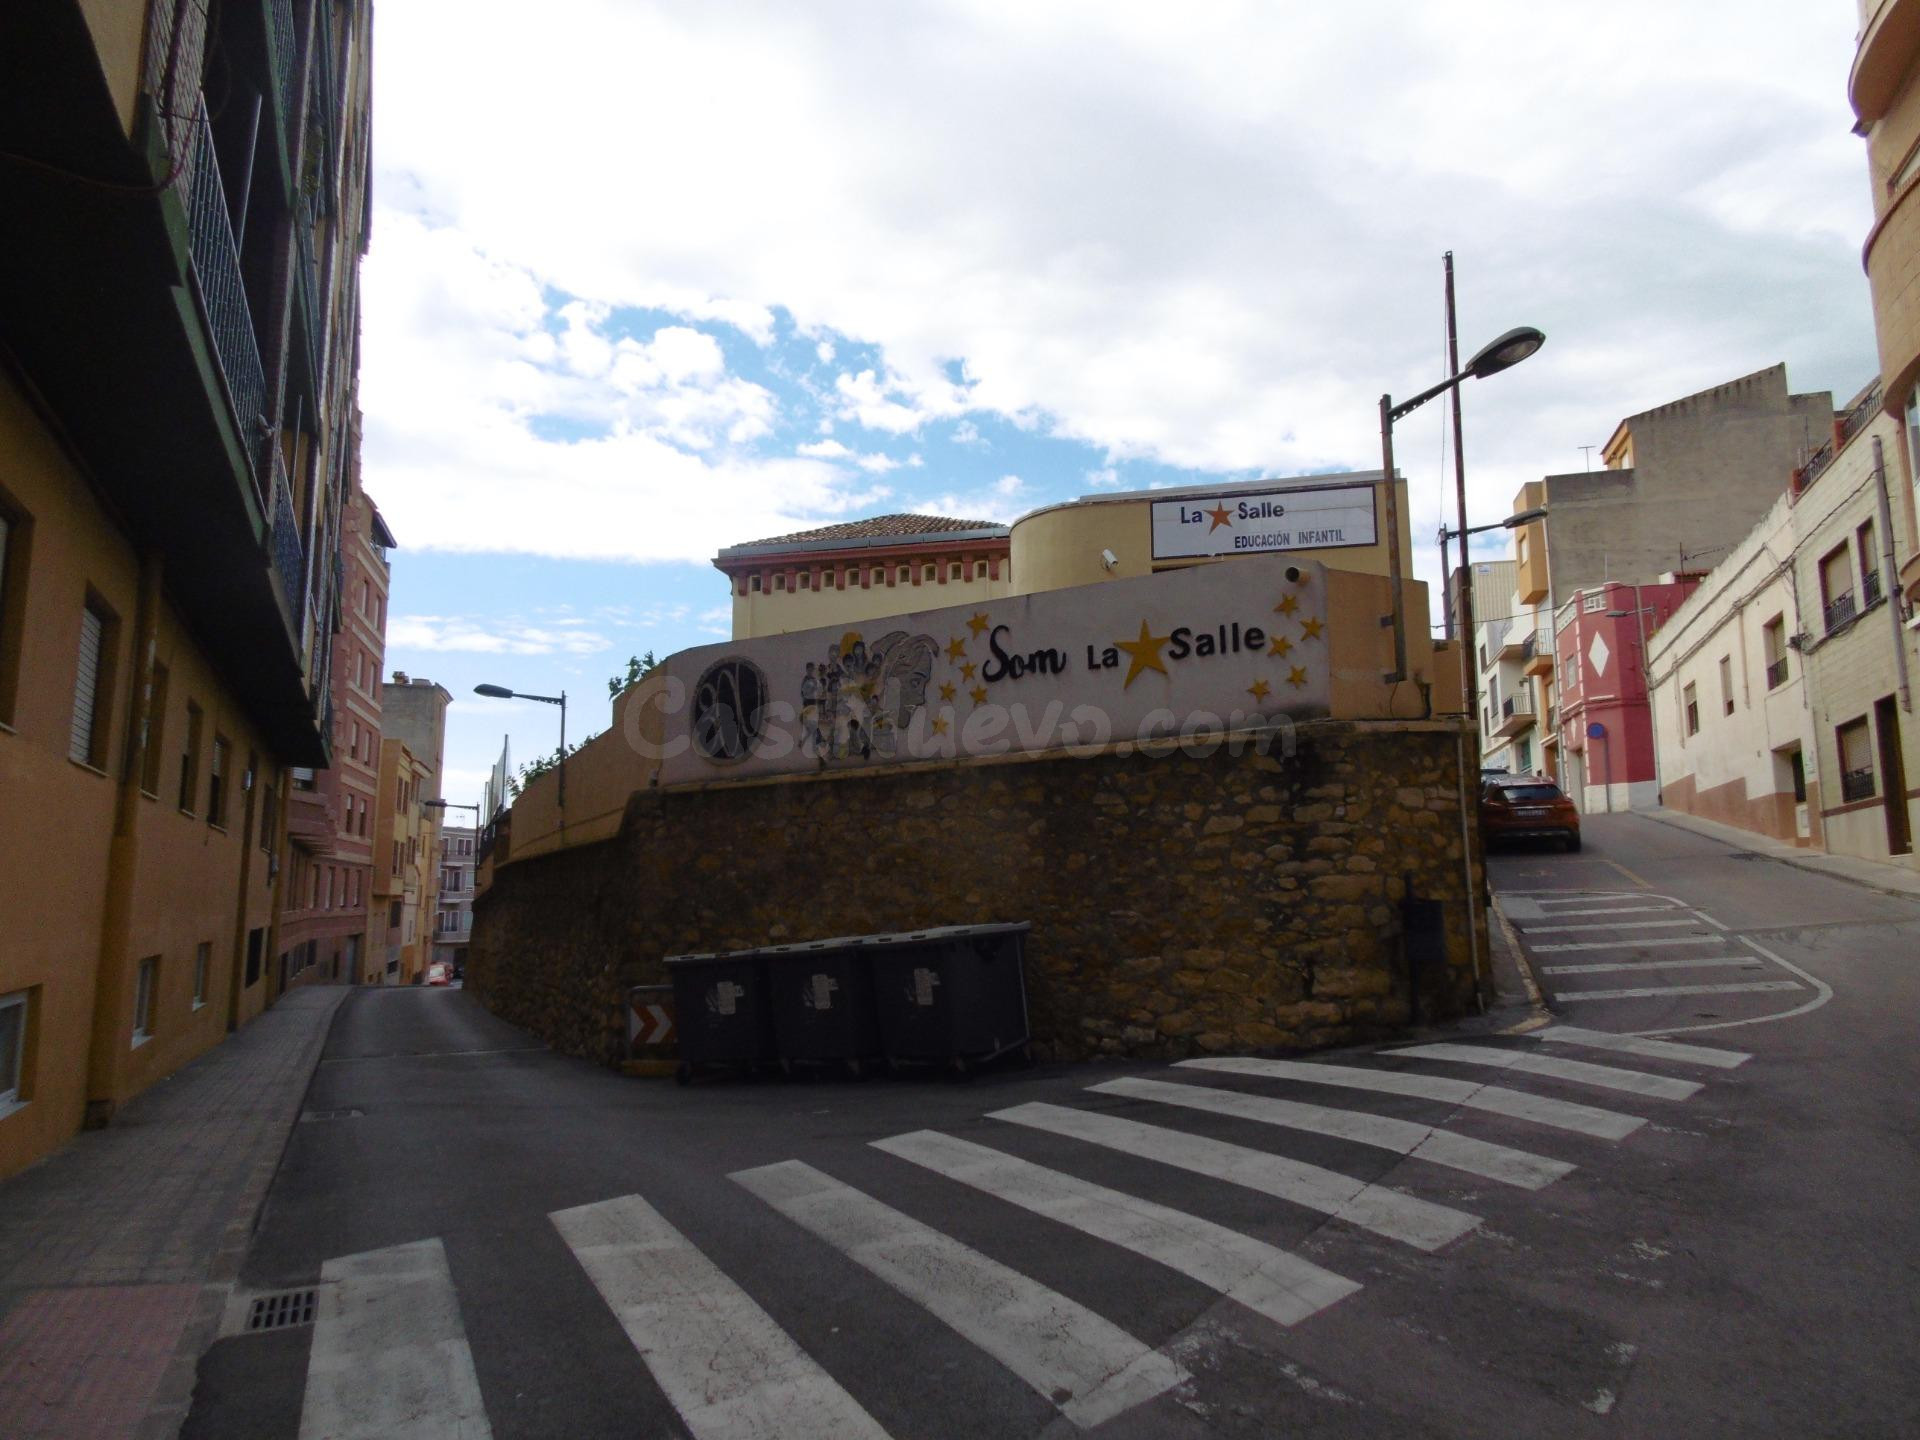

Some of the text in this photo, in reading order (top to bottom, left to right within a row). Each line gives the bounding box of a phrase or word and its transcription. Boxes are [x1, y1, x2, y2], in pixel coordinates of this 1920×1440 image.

[1180, 501, 1285, 524] La Salle
[1234, 529, 1346, 549] EDUCACIÓN INFANTIL
[982, 622, 1266, 683] Som La Salle
